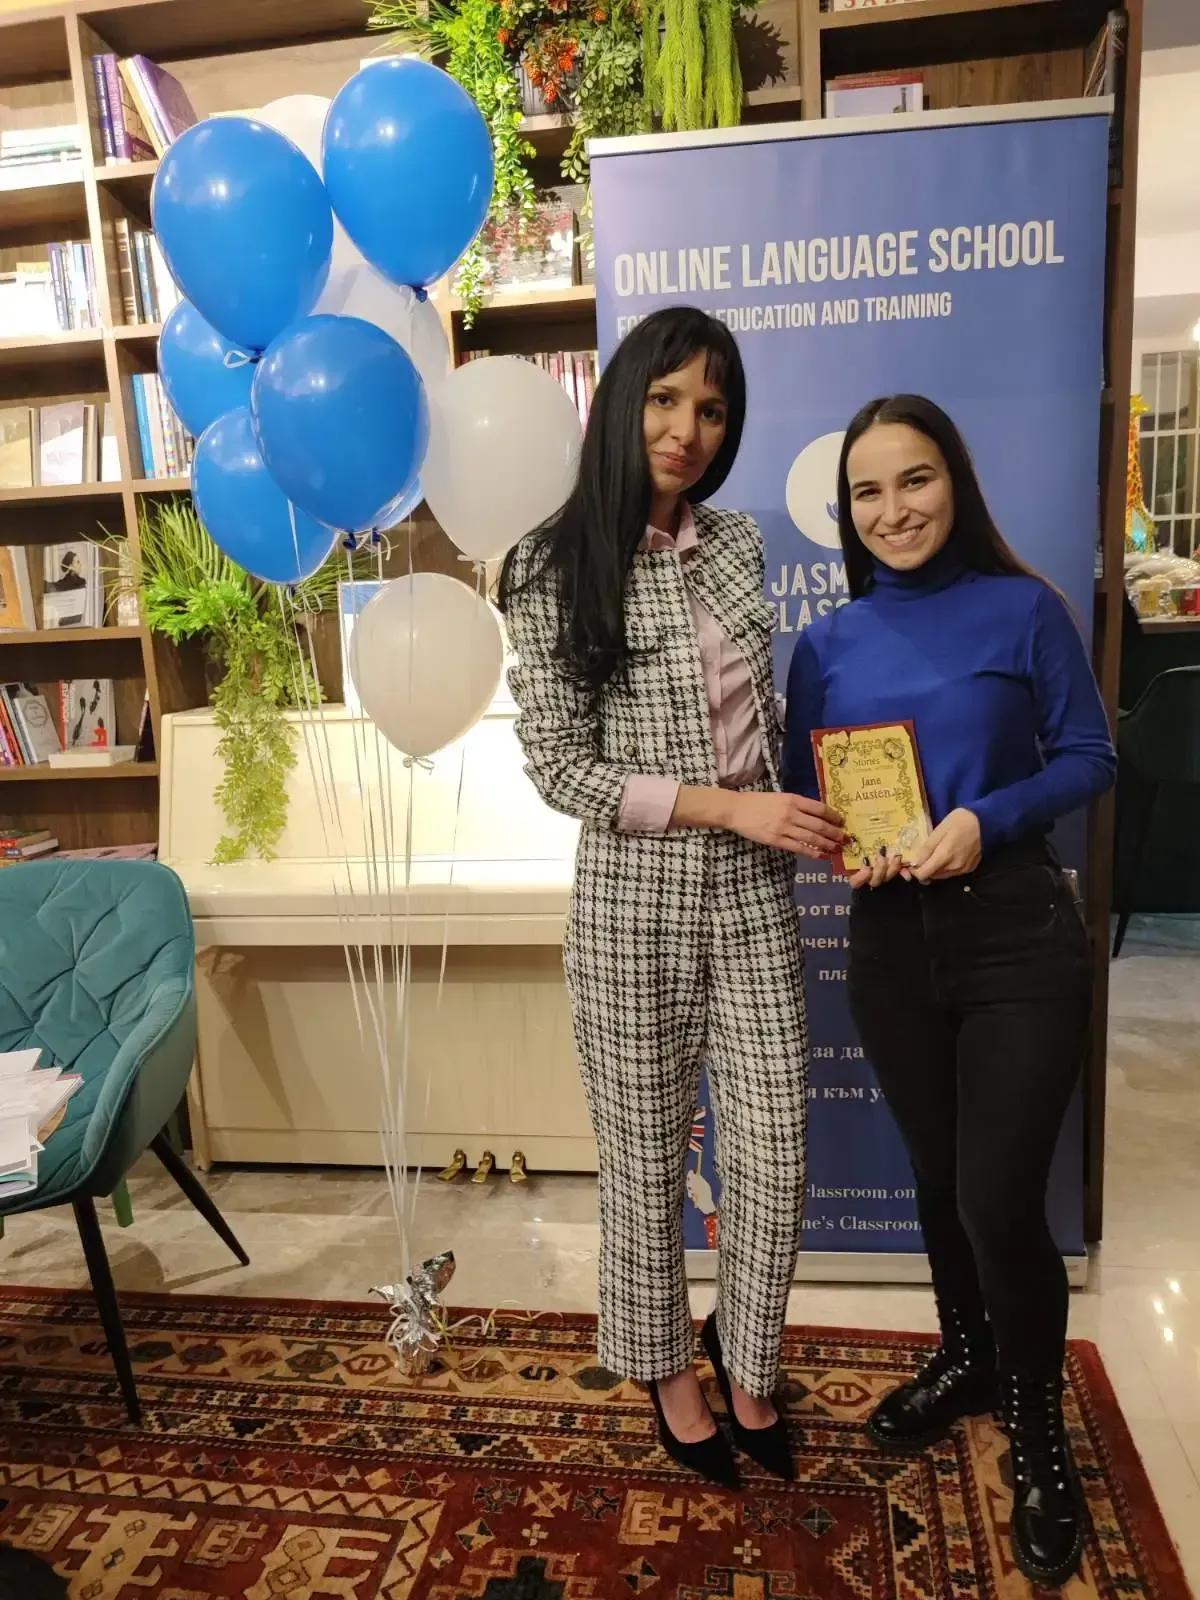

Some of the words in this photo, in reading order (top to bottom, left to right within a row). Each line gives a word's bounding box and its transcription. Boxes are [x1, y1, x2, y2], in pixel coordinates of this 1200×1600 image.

[614, 246, 732, 297] ONLINE
[742, 230, 919, 288] LANGUAGE
[928, 219, 1065, 273] SCHOOL
[616, 313, 648, 340] FO
[820, 299, 860, 326] AND
[863, 291, 952, 323] TRAINING
[861, 776, 882, 789] Jane
[855, 789, 891, 801] Austen
[809, 904, 831, 916] от
[812, 1046, 835, 1059] за
[840, 1046, 865, 1061] да
[823, 1087, 864, 1099] към
[806, 1183, 917, 1200] lassroom.on
